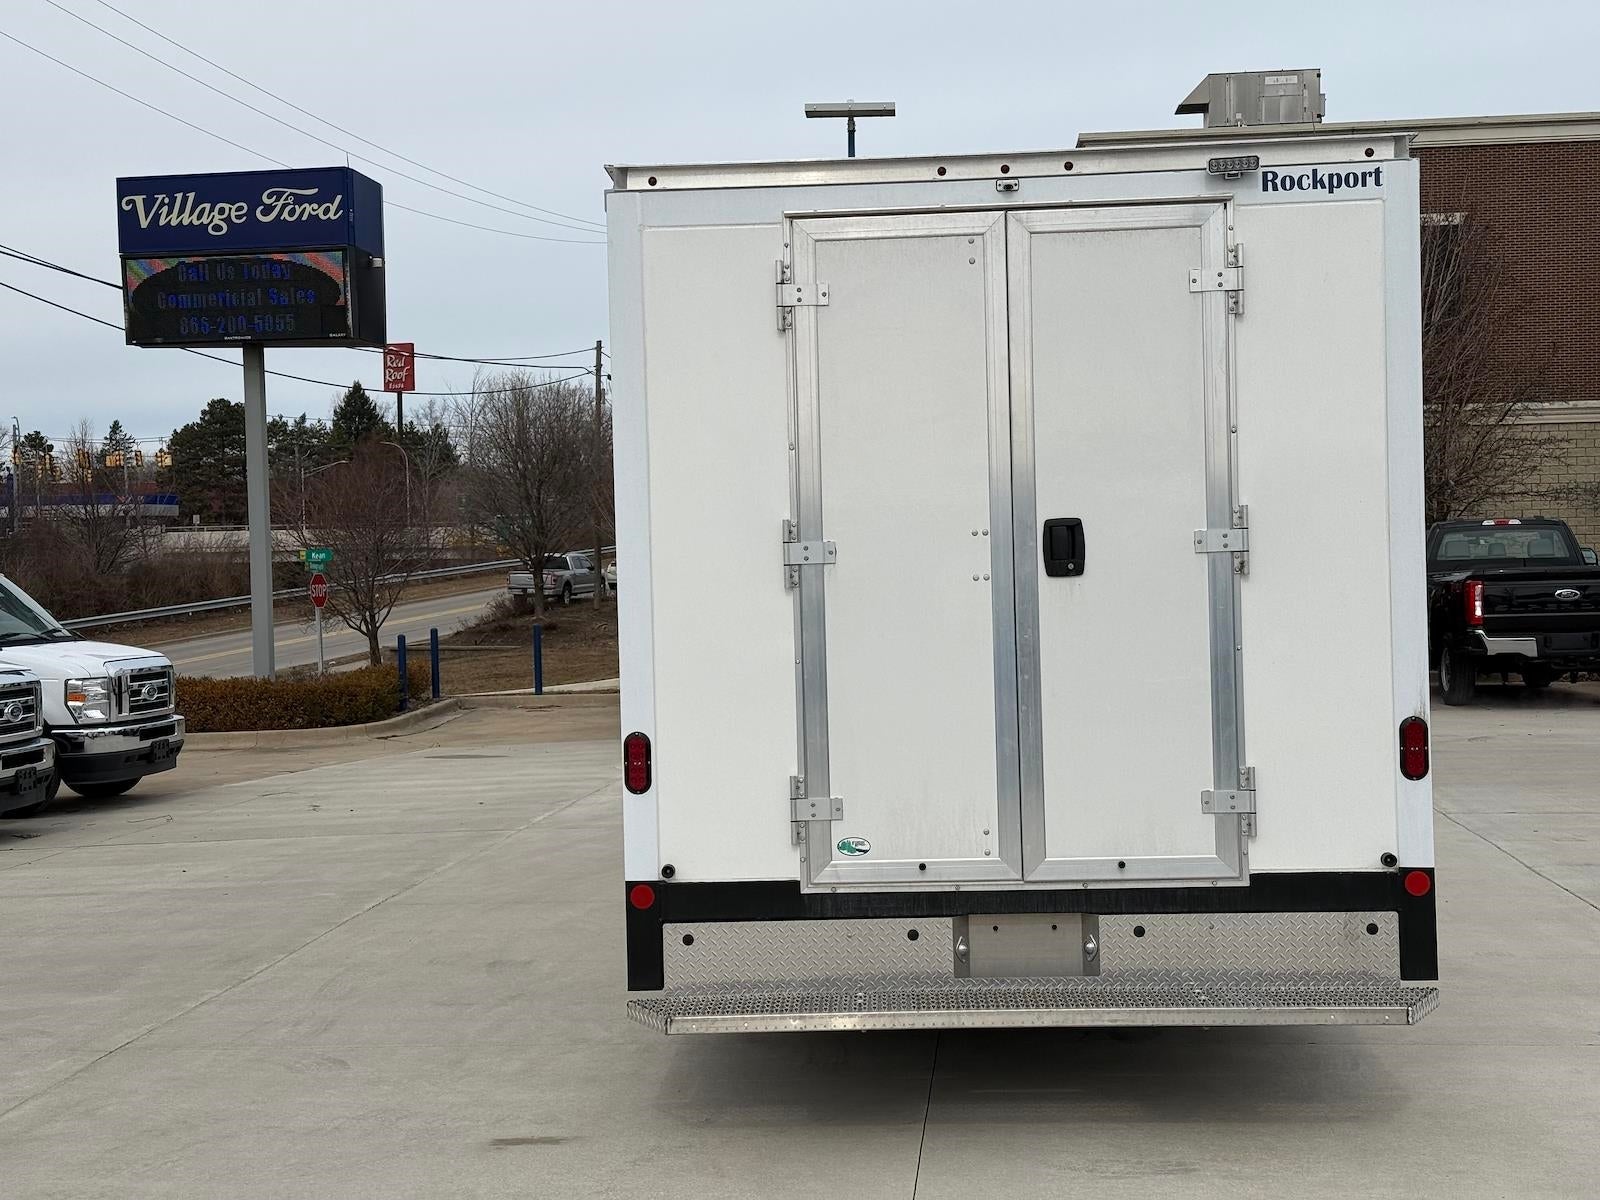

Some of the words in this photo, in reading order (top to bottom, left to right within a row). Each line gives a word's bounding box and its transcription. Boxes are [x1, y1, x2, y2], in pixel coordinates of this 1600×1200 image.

[1261, 166, 1383, 194] Rockport
[121, 191, 248, 236] Village
[255, 187, 343, 223] Ford
[178, 262, 210, 282] Call
[216, 262, 235, 281] Us
[241, 261, 292, 281] Today
[267, 287, 317, 305] Sales
[387, 354, 406, 368] Red
[385, 366, 411, 383] Roof
[311, 584, 327, 598] STOP
